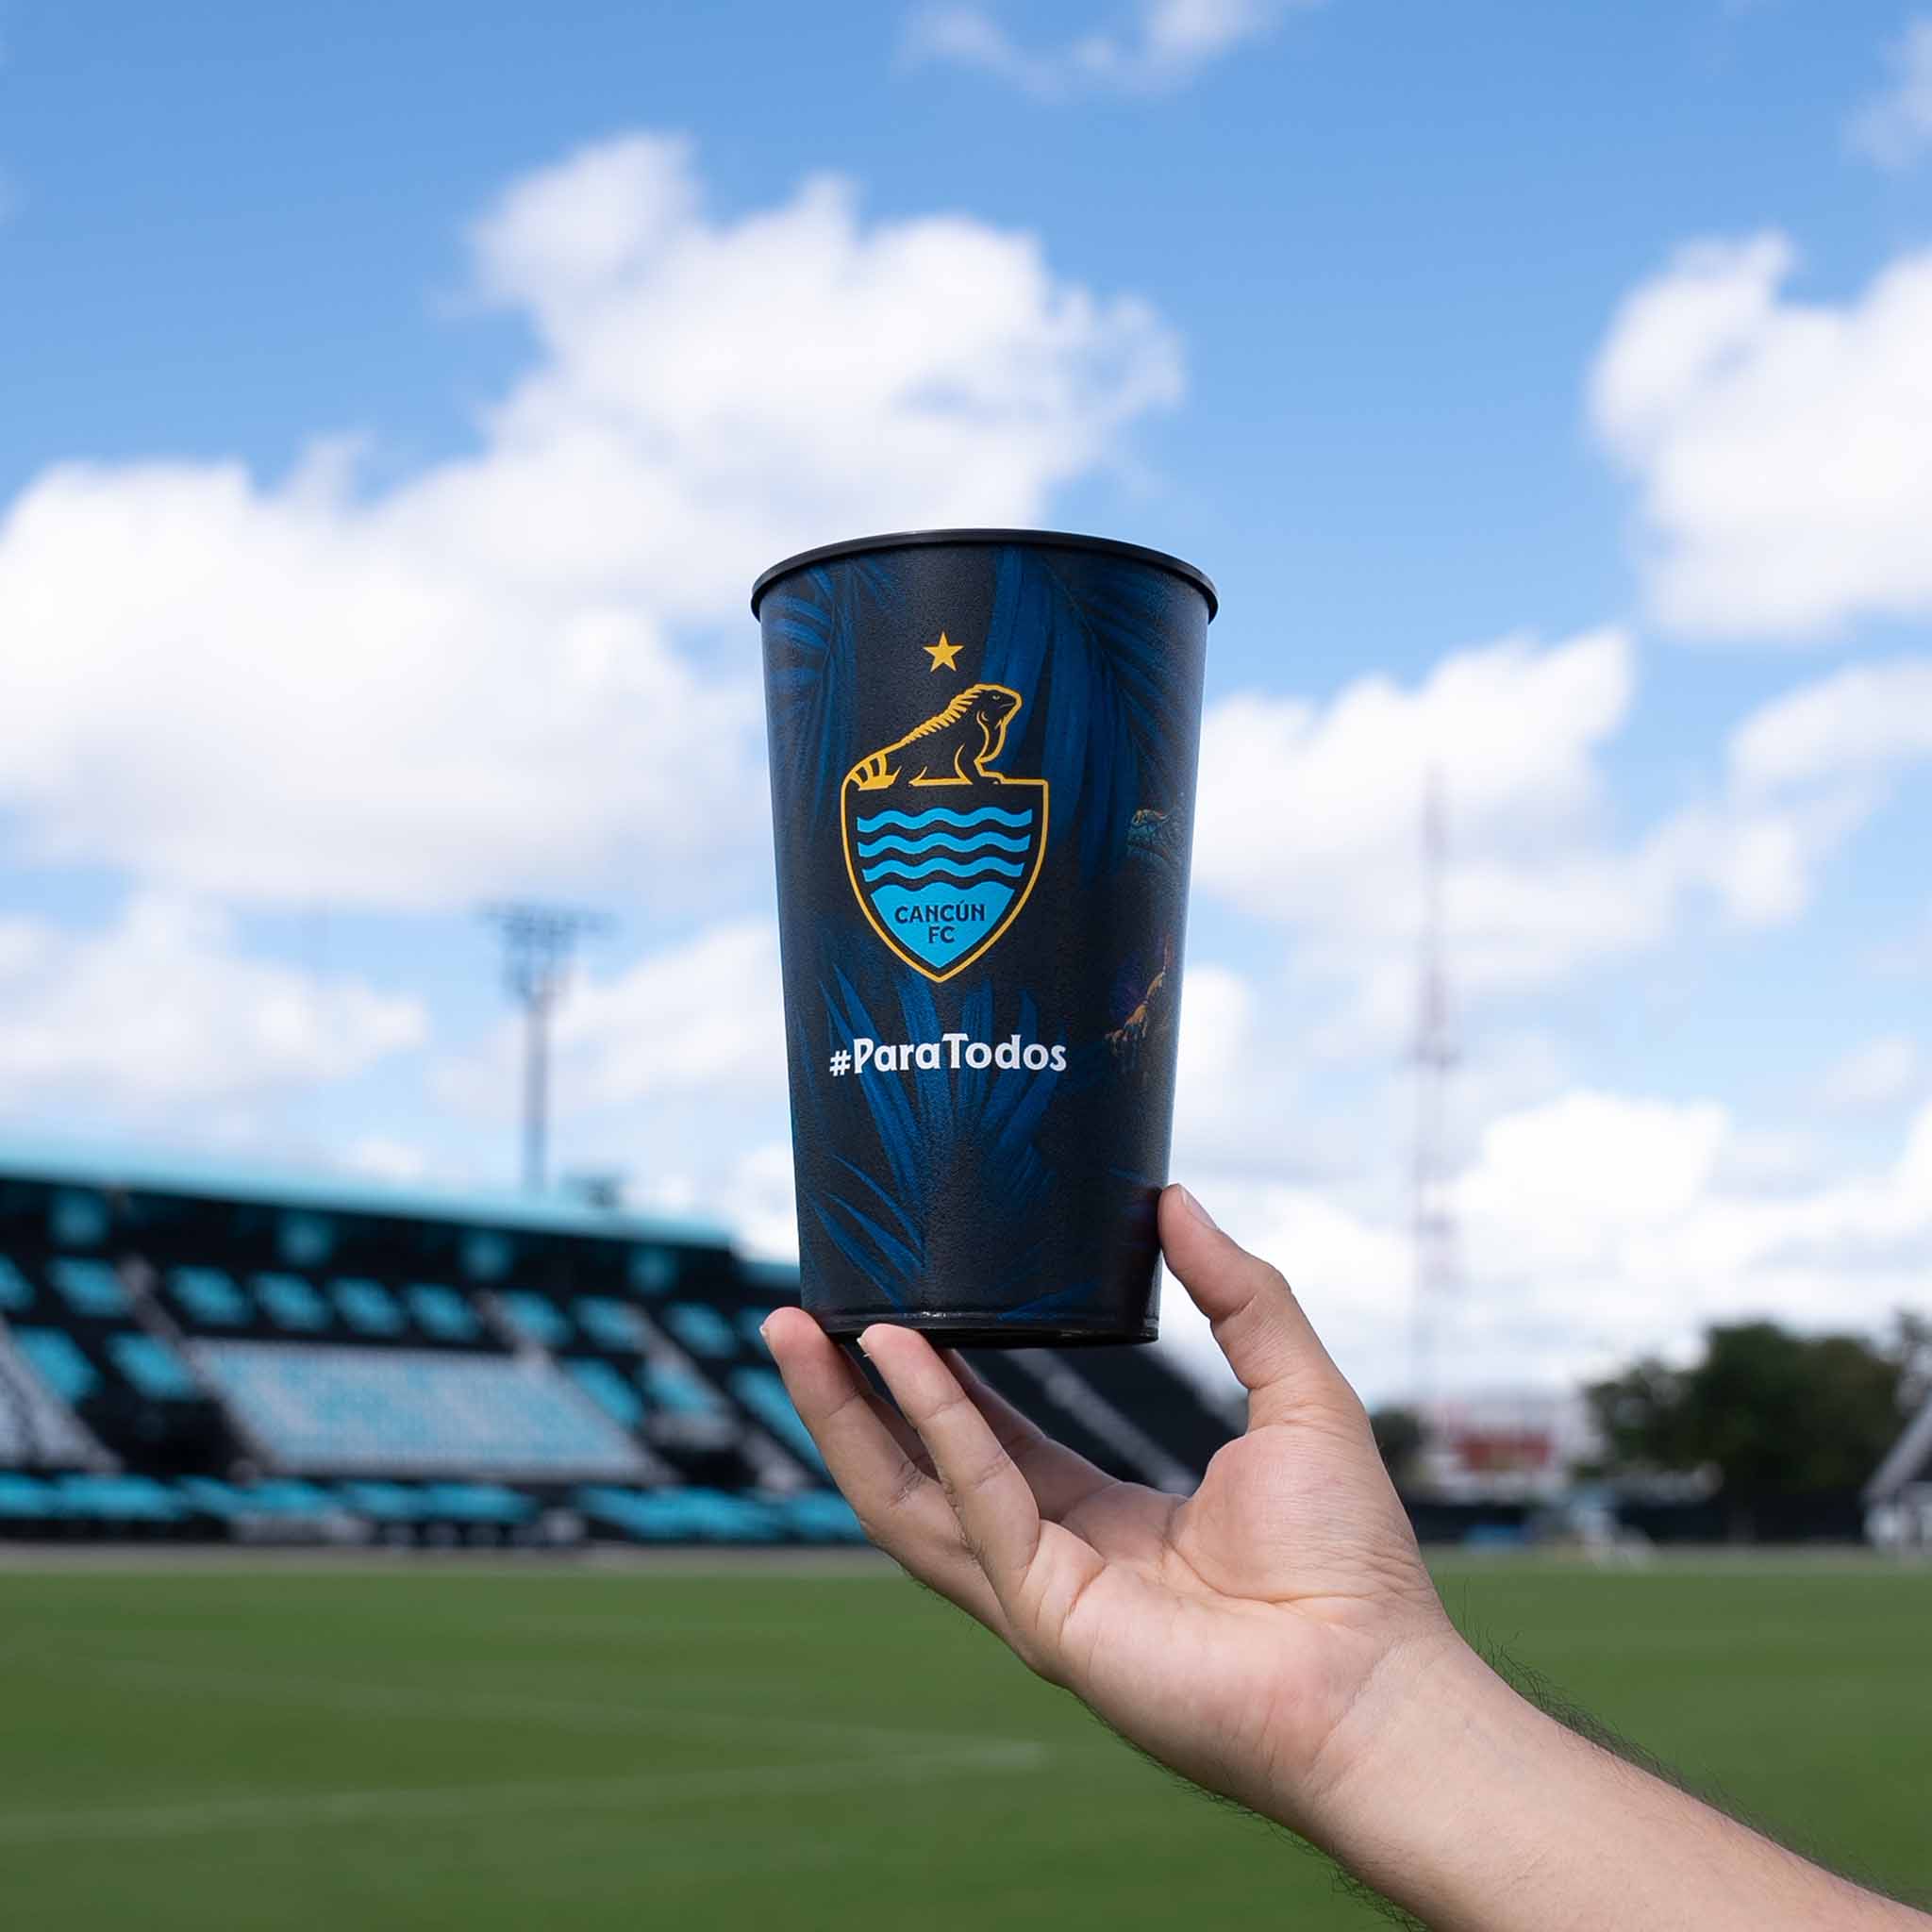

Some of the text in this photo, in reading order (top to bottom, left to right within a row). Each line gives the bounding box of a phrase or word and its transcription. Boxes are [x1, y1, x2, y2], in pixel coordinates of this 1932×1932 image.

[894, 901, 985, 924] CANCÚN
[929, 926, 955, 944] FC
[829, 1033, 1067, 1076] #ParaTodos
